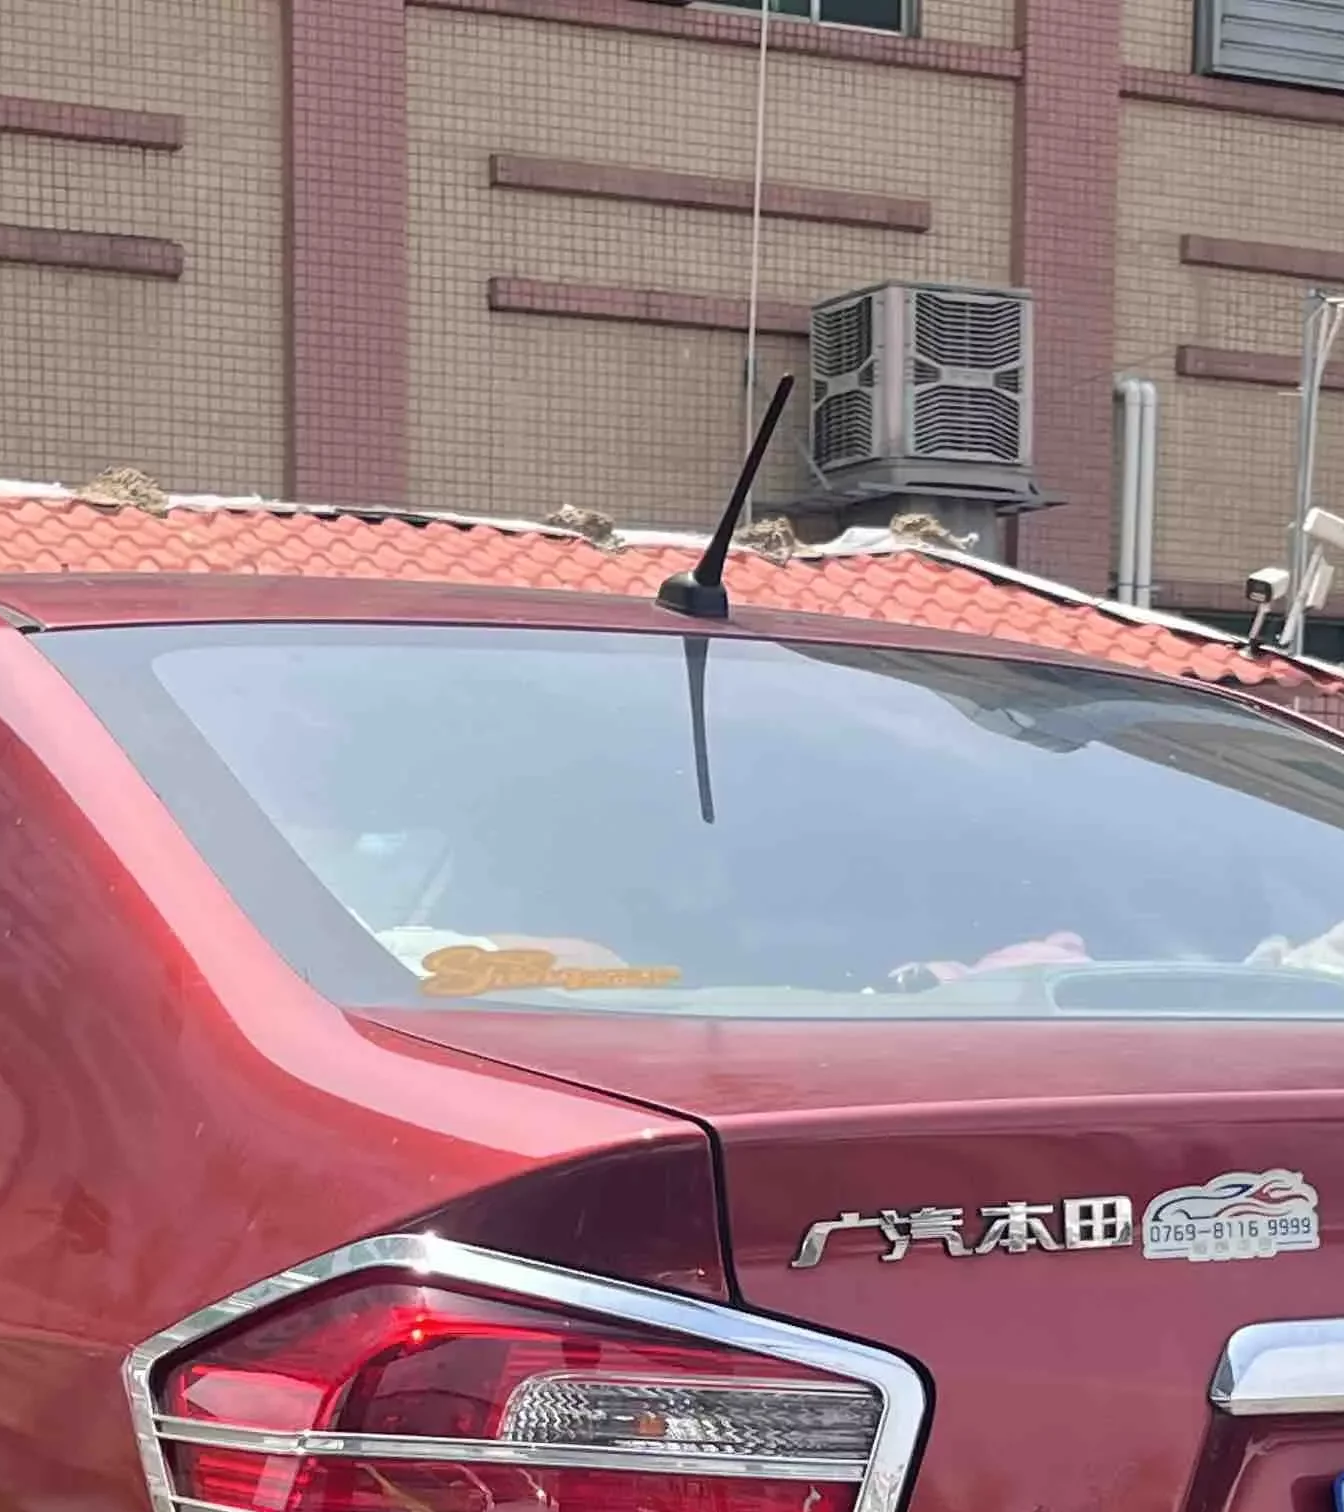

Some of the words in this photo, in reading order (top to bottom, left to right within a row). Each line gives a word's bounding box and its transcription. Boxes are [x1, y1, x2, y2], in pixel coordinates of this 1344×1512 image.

[790, 1195, 1134, 1268] 广汽本田
[1149, 1219, 1260, 1244] 0769-8116
